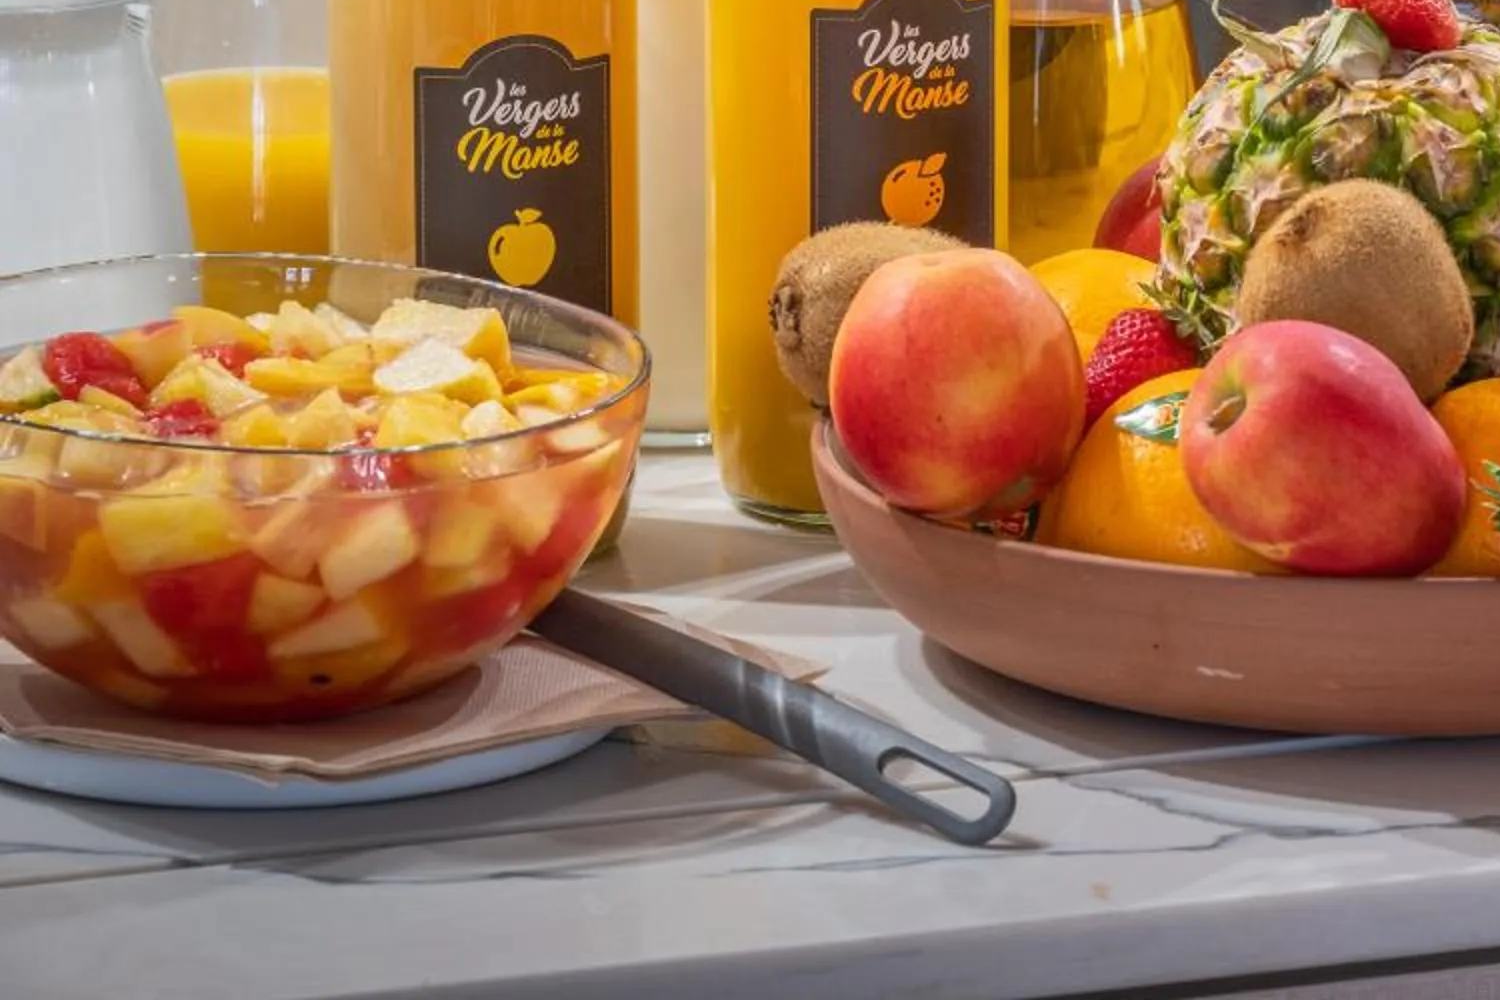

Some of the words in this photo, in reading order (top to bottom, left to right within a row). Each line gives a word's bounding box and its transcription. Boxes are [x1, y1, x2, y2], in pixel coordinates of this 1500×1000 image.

[904, 25, 920, 38] les
[858, 19, 971, 79] Vergers
[509, 82, 527, 97] les
[929, 68, 943, 79] de
[463, 78, 581, 139] Vergers
[852, 67, 970, 120] Manse
[536, 126, 551, 138] de
[457, 127, 580, 180] Manse
